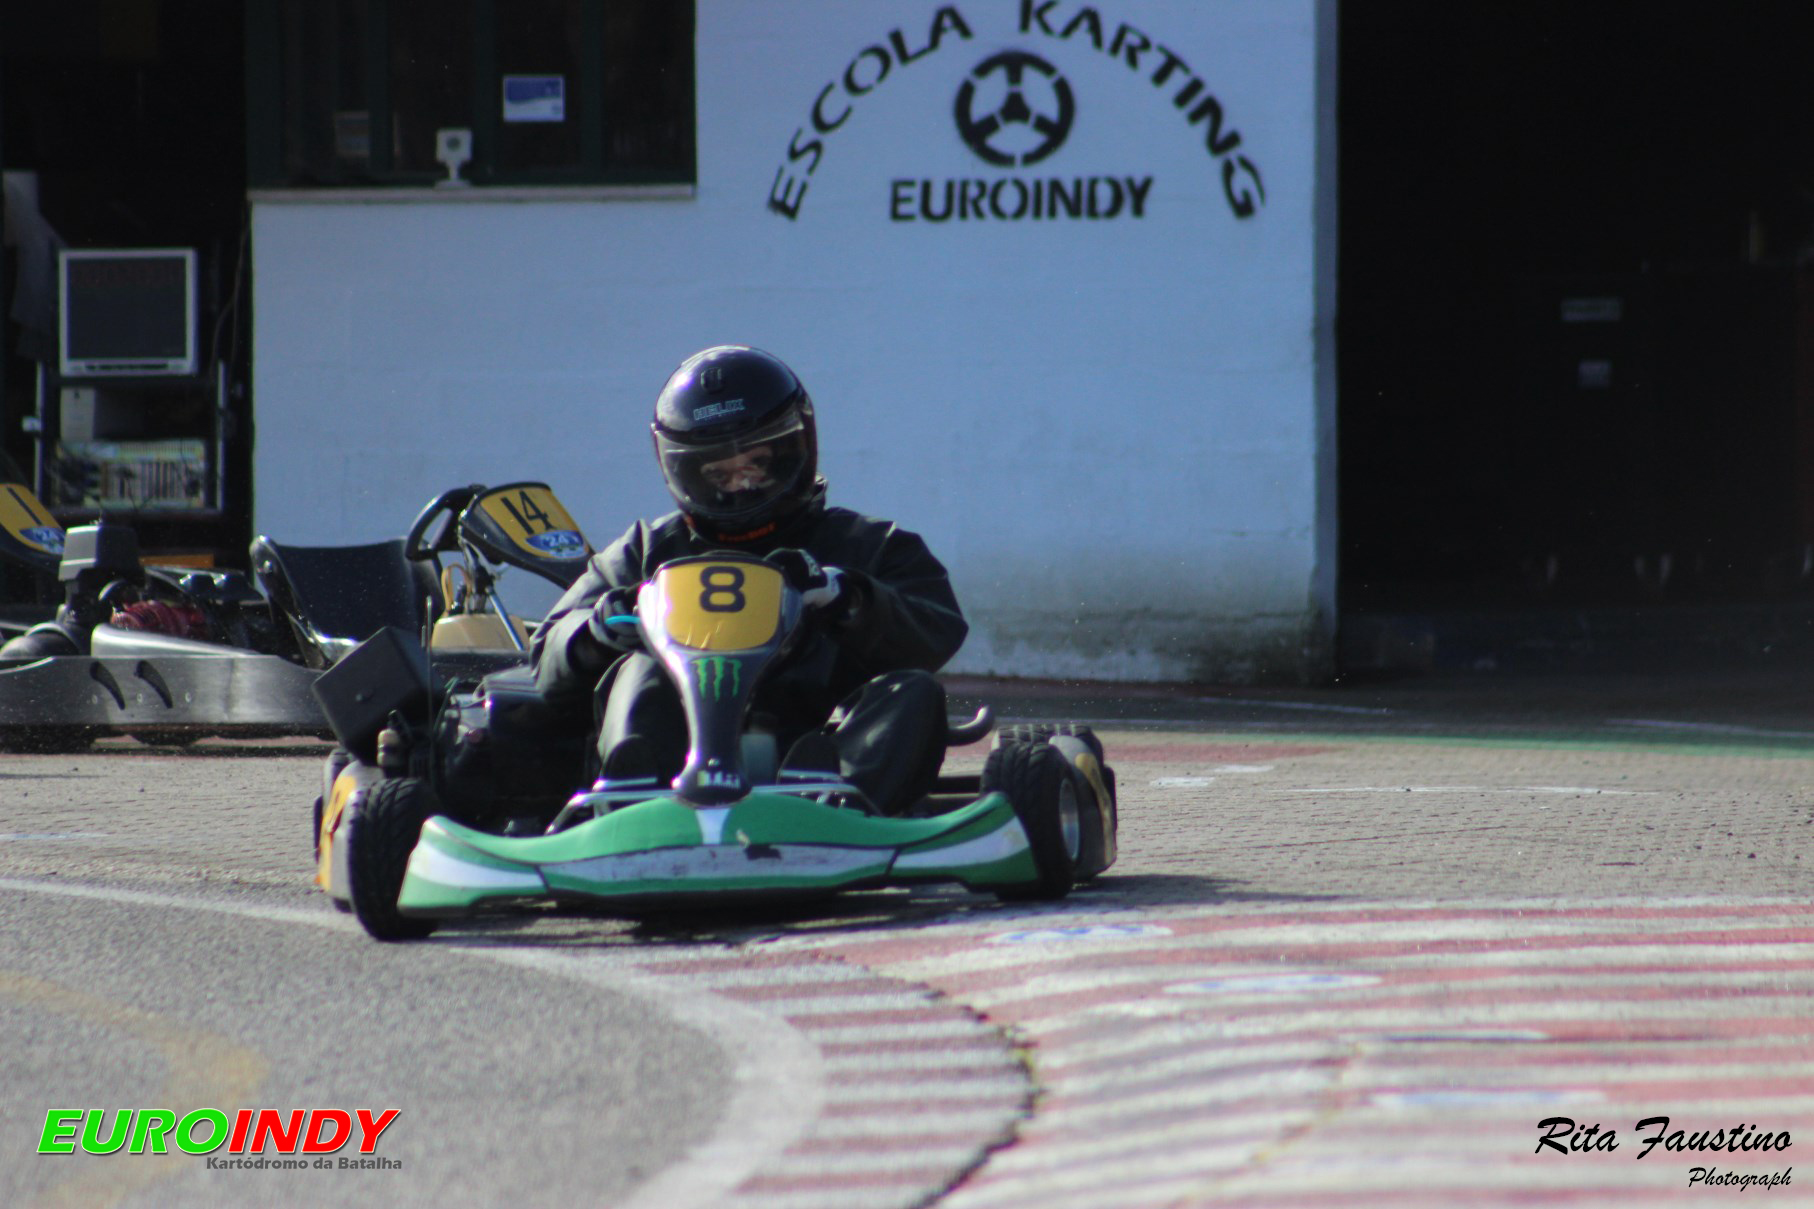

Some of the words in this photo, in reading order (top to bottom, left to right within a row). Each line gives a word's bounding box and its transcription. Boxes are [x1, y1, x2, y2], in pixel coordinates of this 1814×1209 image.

[767, 3, 974, 221] ESCOLA
[1018, 0, 1266, 219] KARTING
[890, 176, 1153, 222] EUROINDY
[500, 489, 556, 536] 14
[699, 566, 746, 613] 8
